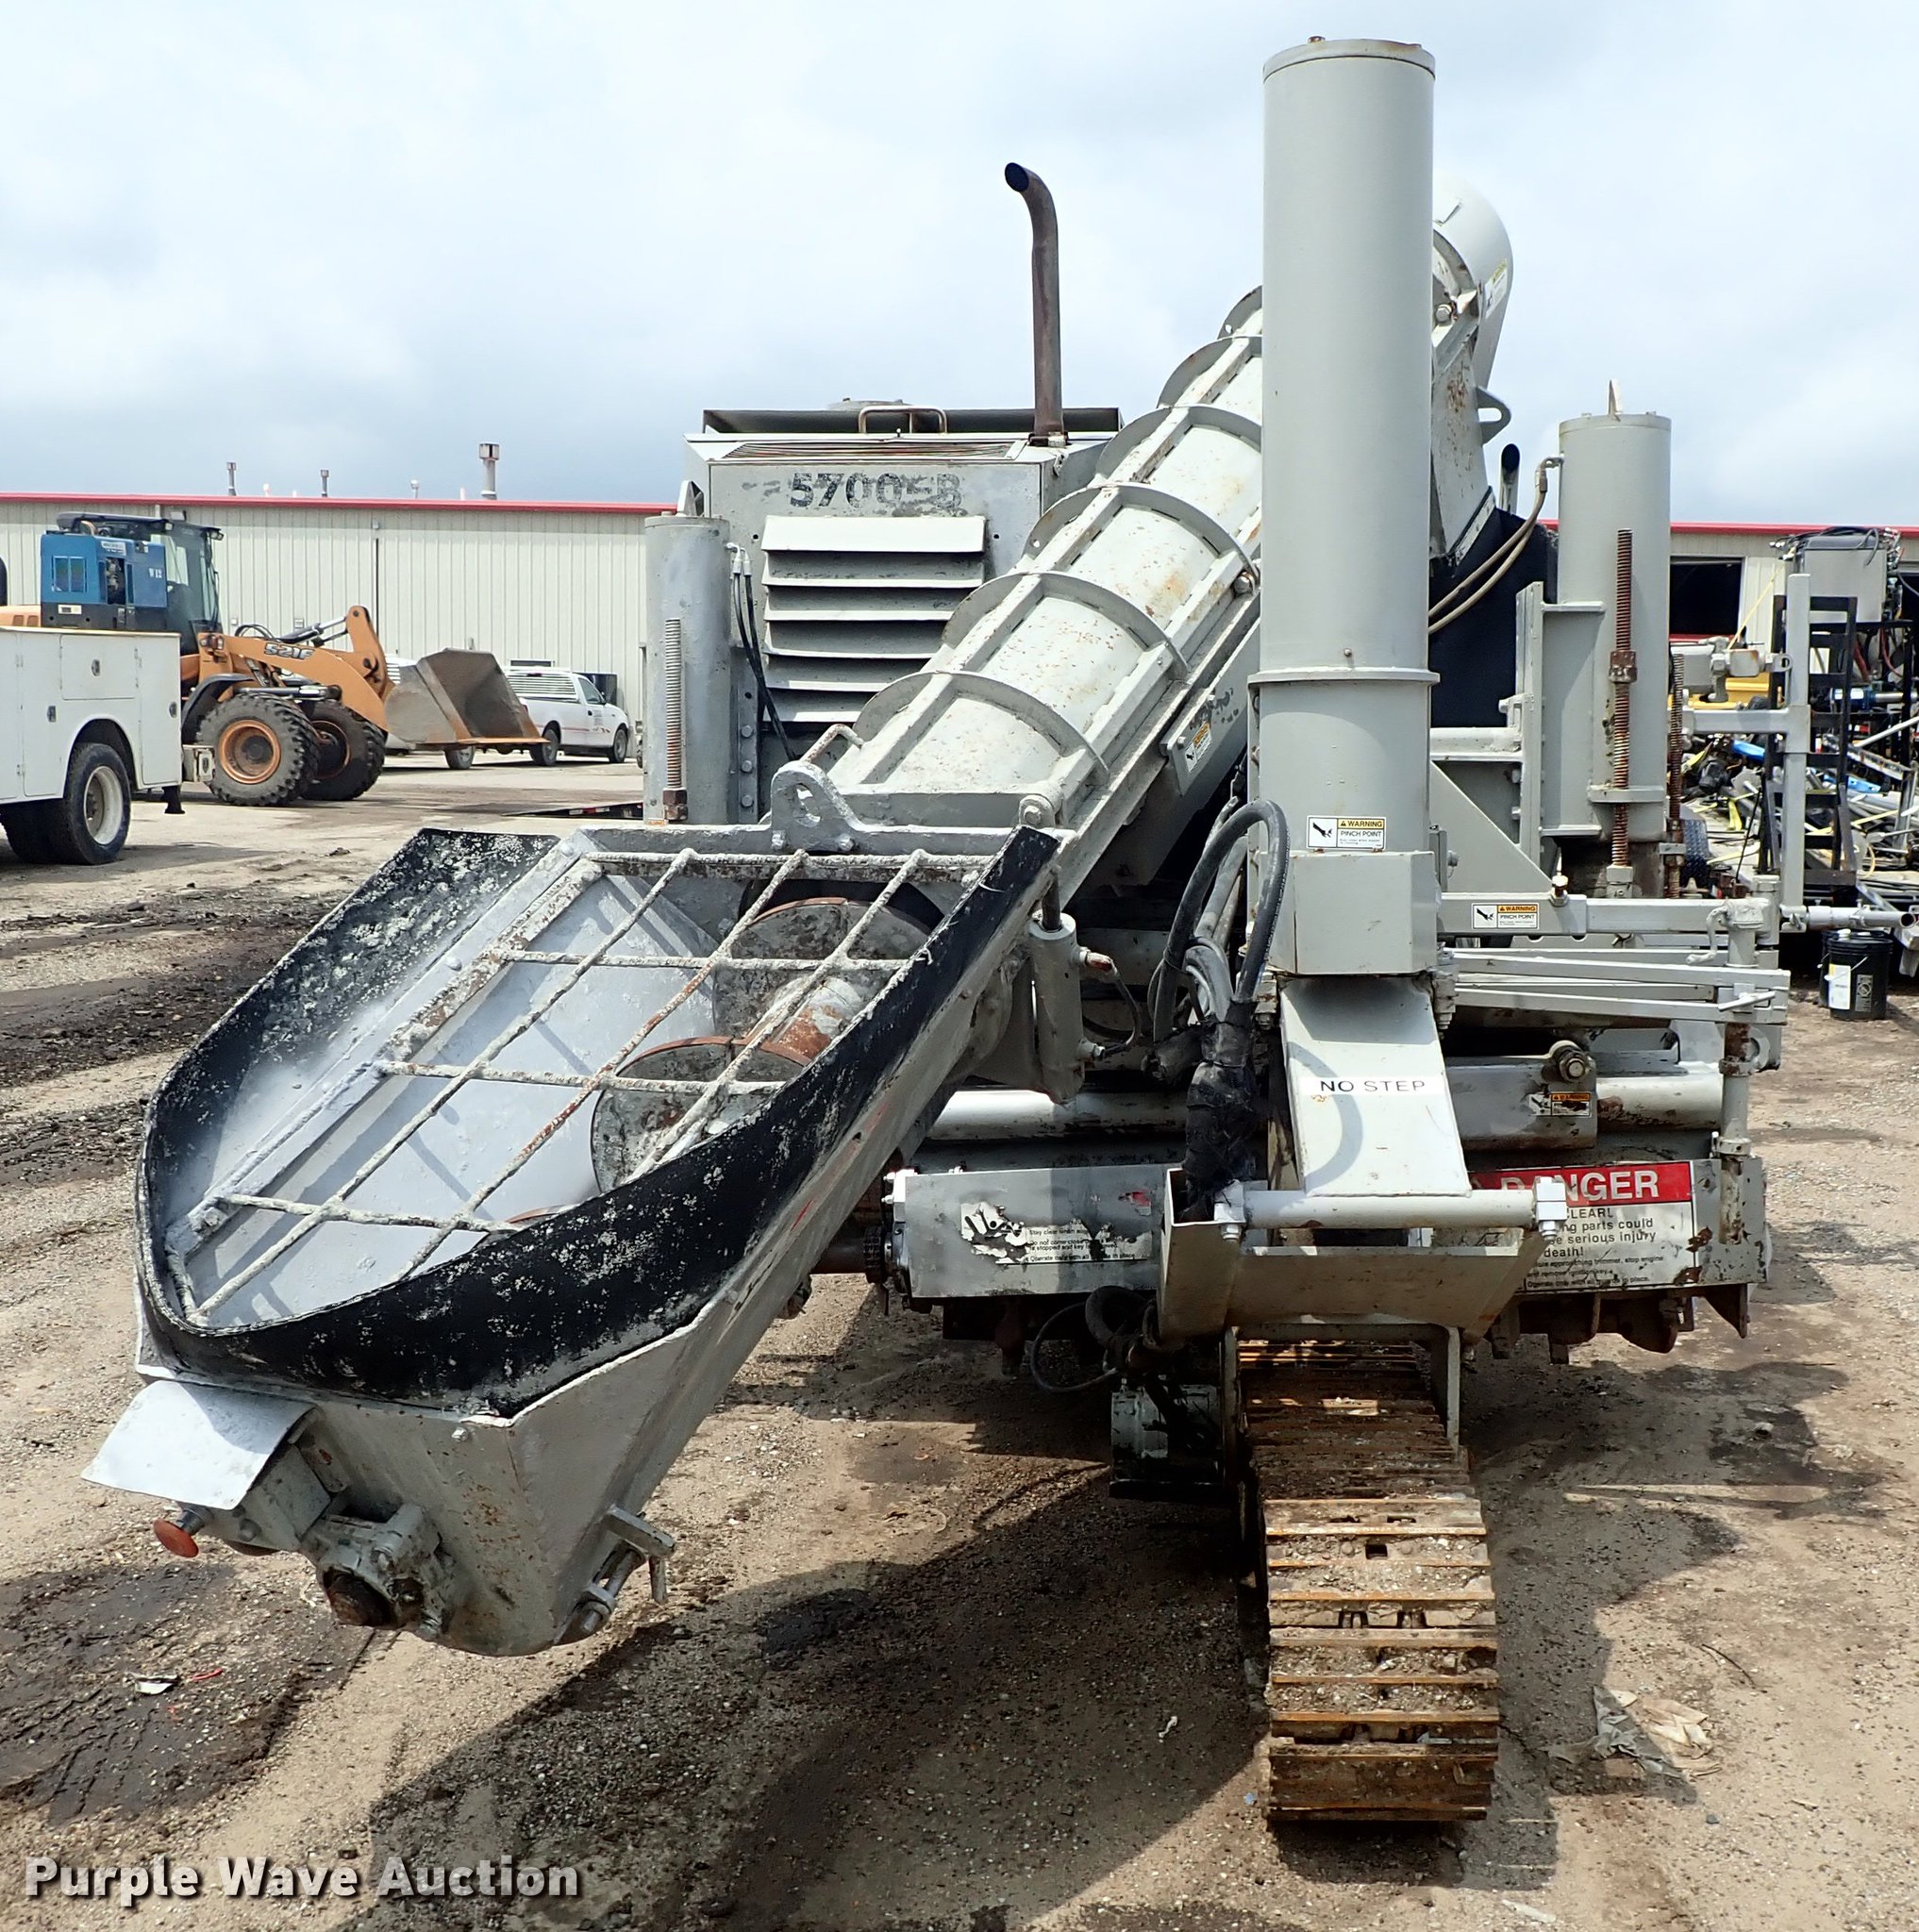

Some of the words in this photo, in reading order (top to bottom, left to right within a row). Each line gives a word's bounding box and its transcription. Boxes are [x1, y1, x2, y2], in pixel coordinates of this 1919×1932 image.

[1320, 1080, 1354, 1092] NO
[1364, 1080, 1425, 1092] STEP
[1501, 1169, 1659, 1202] NGER
[1566, 1208, 1613, 1219] LEAR!
[1582, 1221, 1614, 1233] parts
[1618, 1217, 1653, 1229] could
[1567, 1233, 1615, 1244] serious
[1620, 1230, 1656, 1243] injury
[1544, 1246, 1583, 1257] death!
